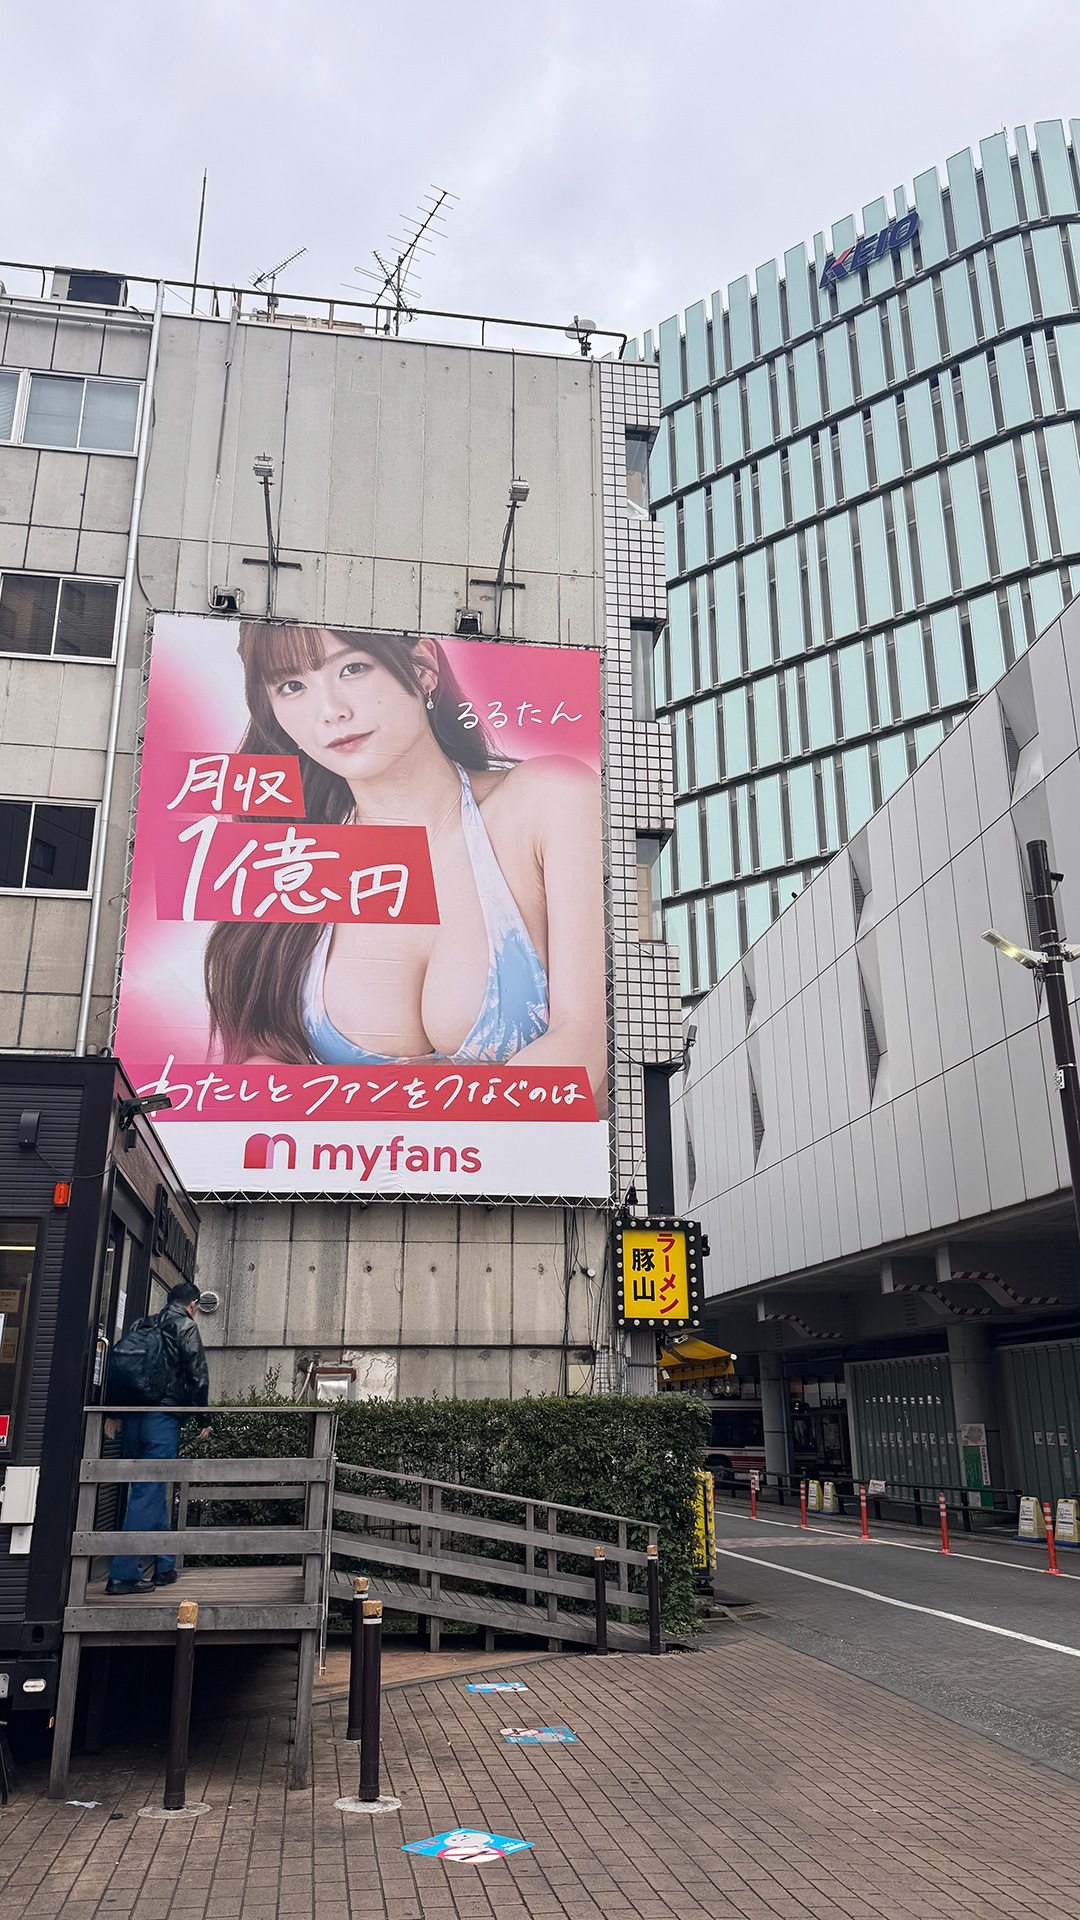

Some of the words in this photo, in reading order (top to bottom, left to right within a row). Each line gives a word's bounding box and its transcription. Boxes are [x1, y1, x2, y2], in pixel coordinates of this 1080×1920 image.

[819, 211, 919, 289] KEIO
[457, 701, 583, 729] るるたん
[167, 754, 293, 812] 月収
[178, 815, 409, 922] 1億円
[312, 1135, 483, 1182] myfans
[631, 1248, 656, 1302] 豚山
[656, 1233, 680, 1315] ラーメン
